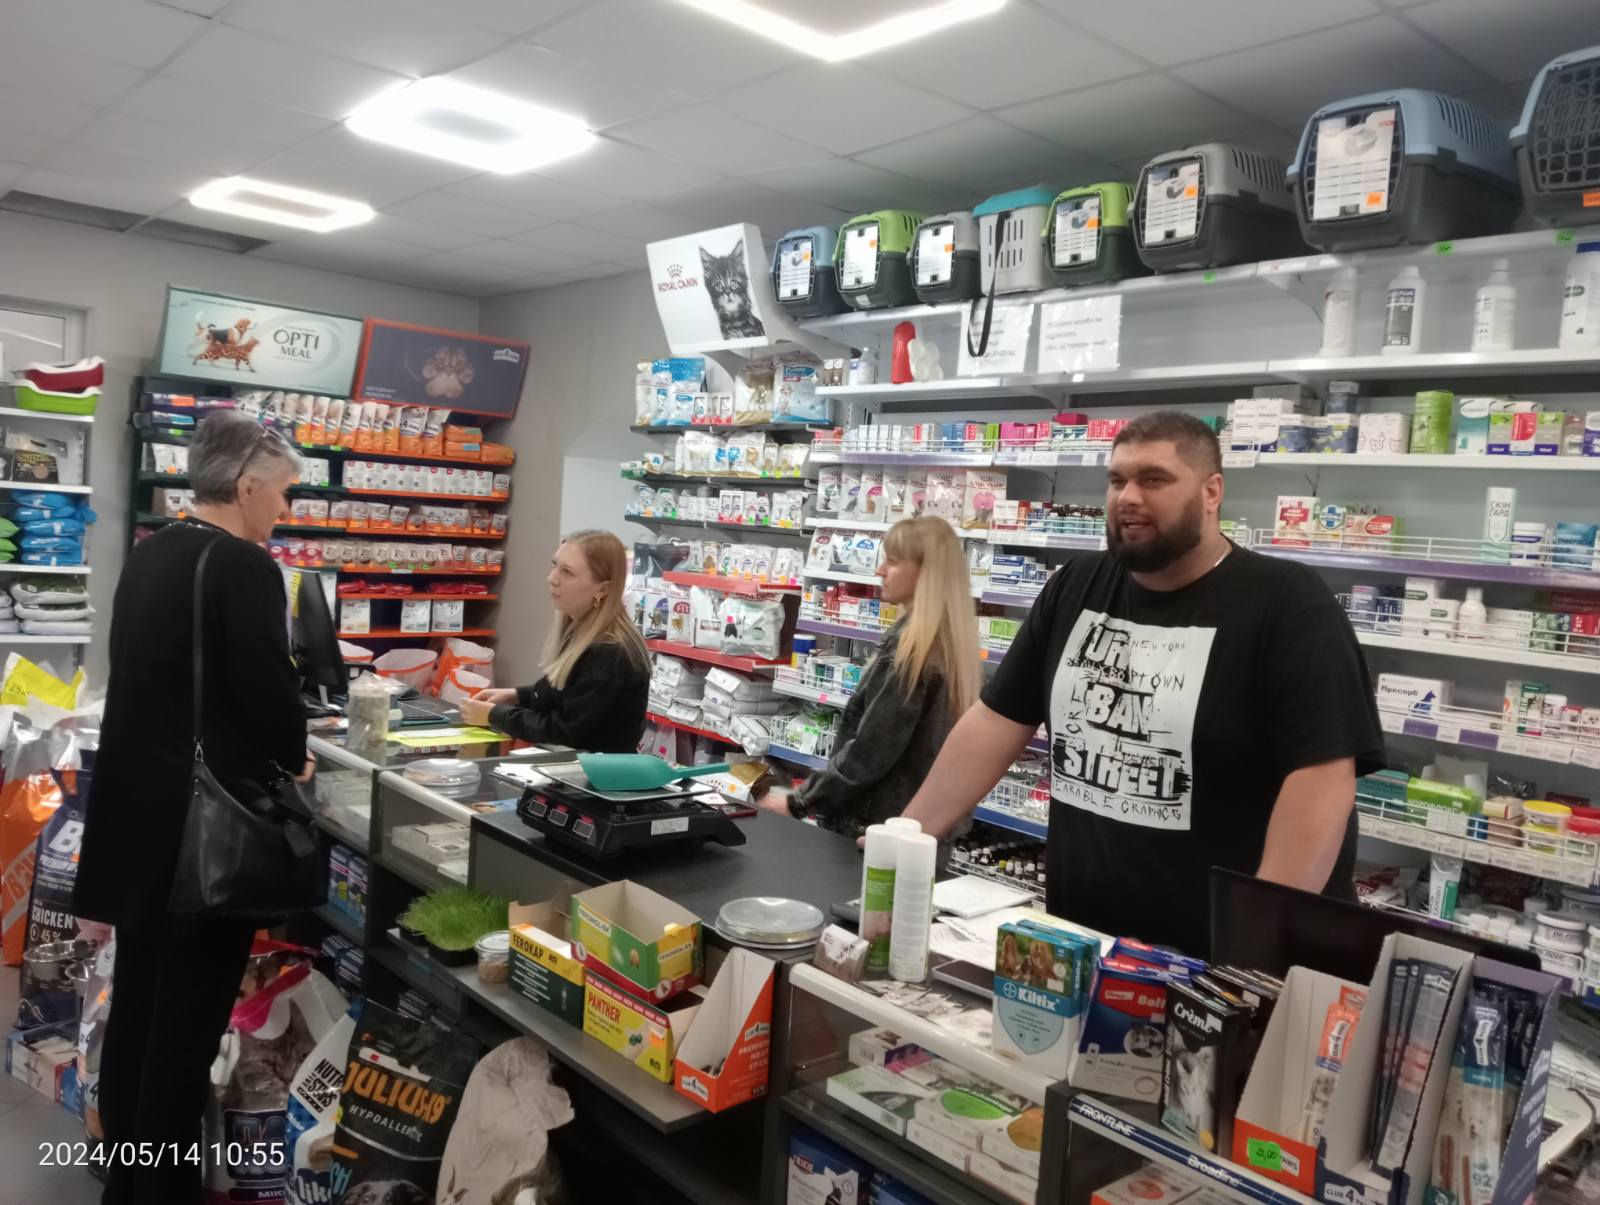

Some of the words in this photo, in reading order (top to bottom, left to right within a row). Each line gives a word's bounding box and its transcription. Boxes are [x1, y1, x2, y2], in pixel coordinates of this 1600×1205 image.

[273, 329, 319, 349] OPTI
[280, 346, 312, 359] MEAL
[1131, 640, 1157, 650] NEW
[1381, 685, 1418, 697] Пресорб
[1064, 740, 1179, 798] STREET
[1121, 800, 1183, 821] GRAPHICS
[32, 905, 74, 929] CHICKEN
[40, 929, 51, 942] 45
[588, 991, 621, 1024] PANTHER
[1018, 987, 1057, 1011] Kiltix
[1078, 1104, 1136, 1136] FRONTLINE
[1188, 1154, 1241, 1187] Broadline
[1472, 1174, 1492, 1187] 92
[1325, 1188, 1345, 1199] CLUB
[1345, 1188, 1354, 1203] 4
